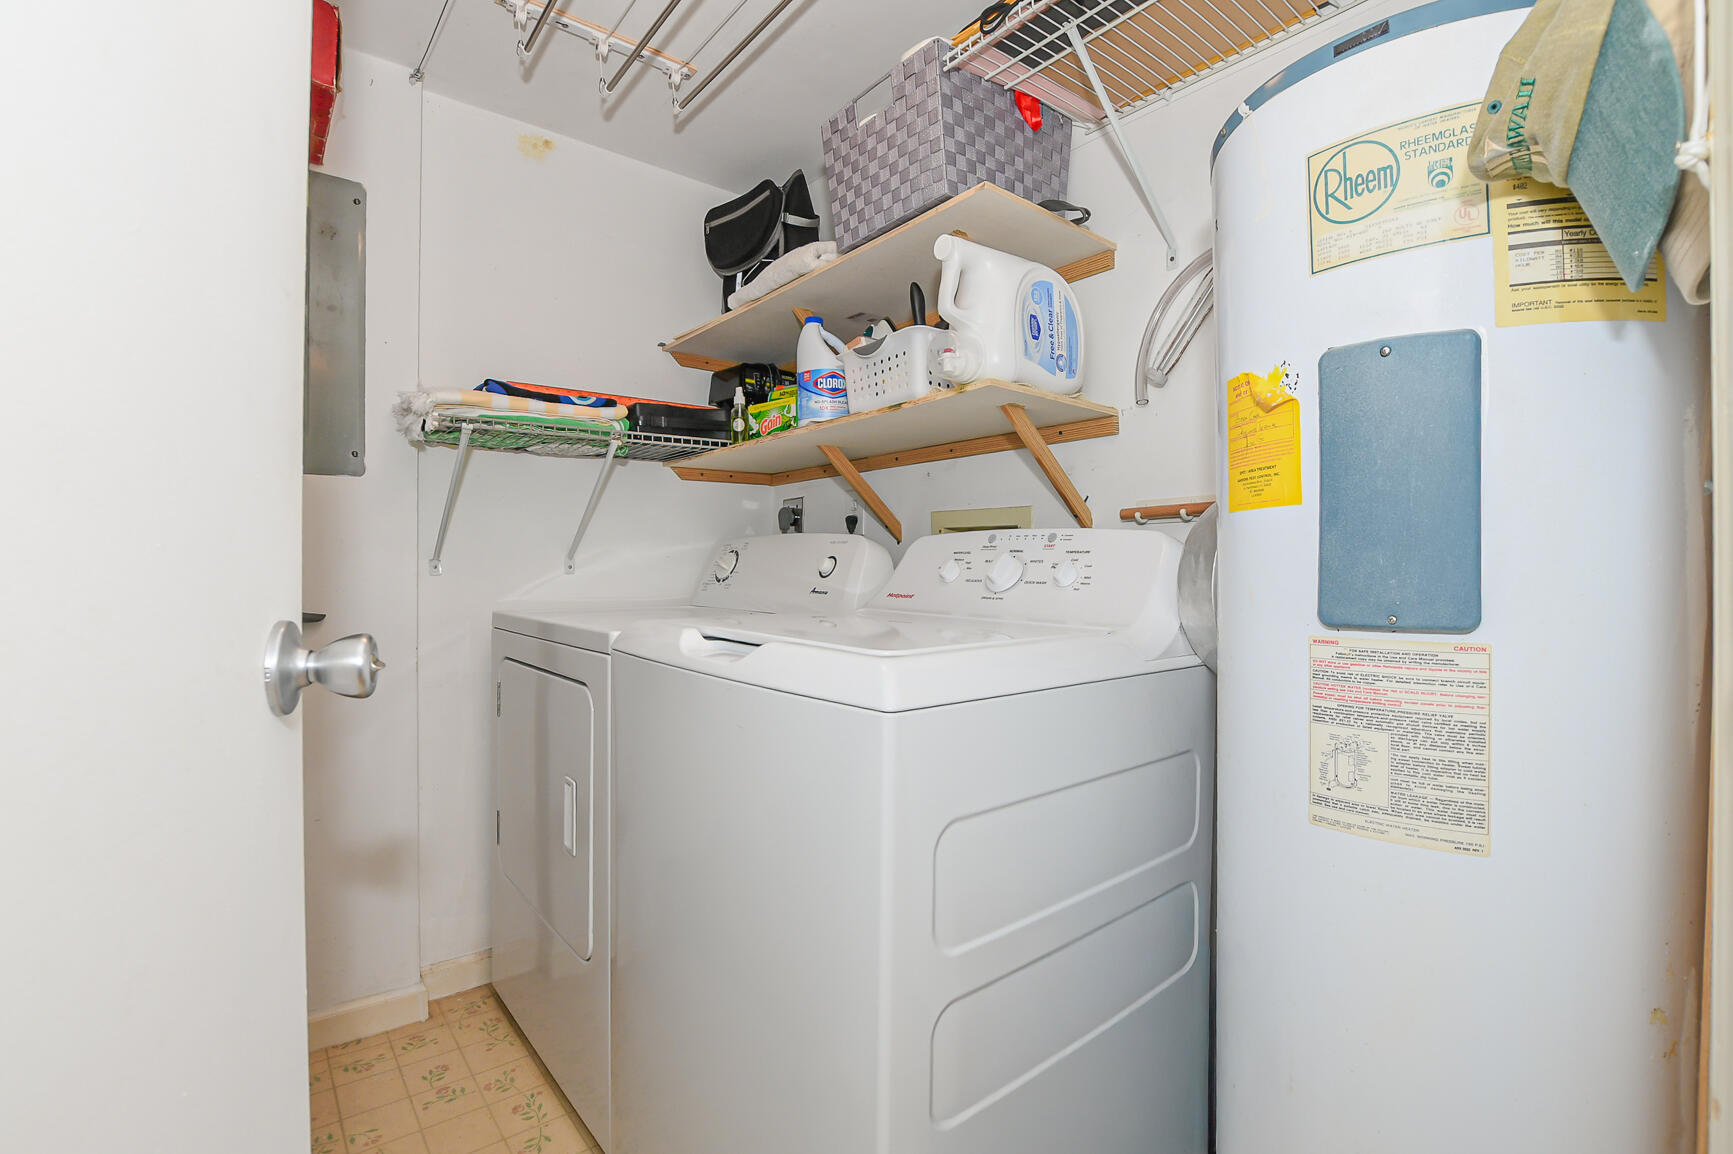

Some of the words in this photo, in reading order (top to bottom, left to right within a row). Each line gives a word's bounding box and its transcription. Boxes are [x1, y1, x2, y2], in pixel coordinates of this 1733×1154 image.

[1323, 151, 1394, 216] Rheem
[1564, 230, 1587, 238] Yearly
[1512, 300, 1552, 308] IMPORTANT
[760, 412, 782, 436] Gain
